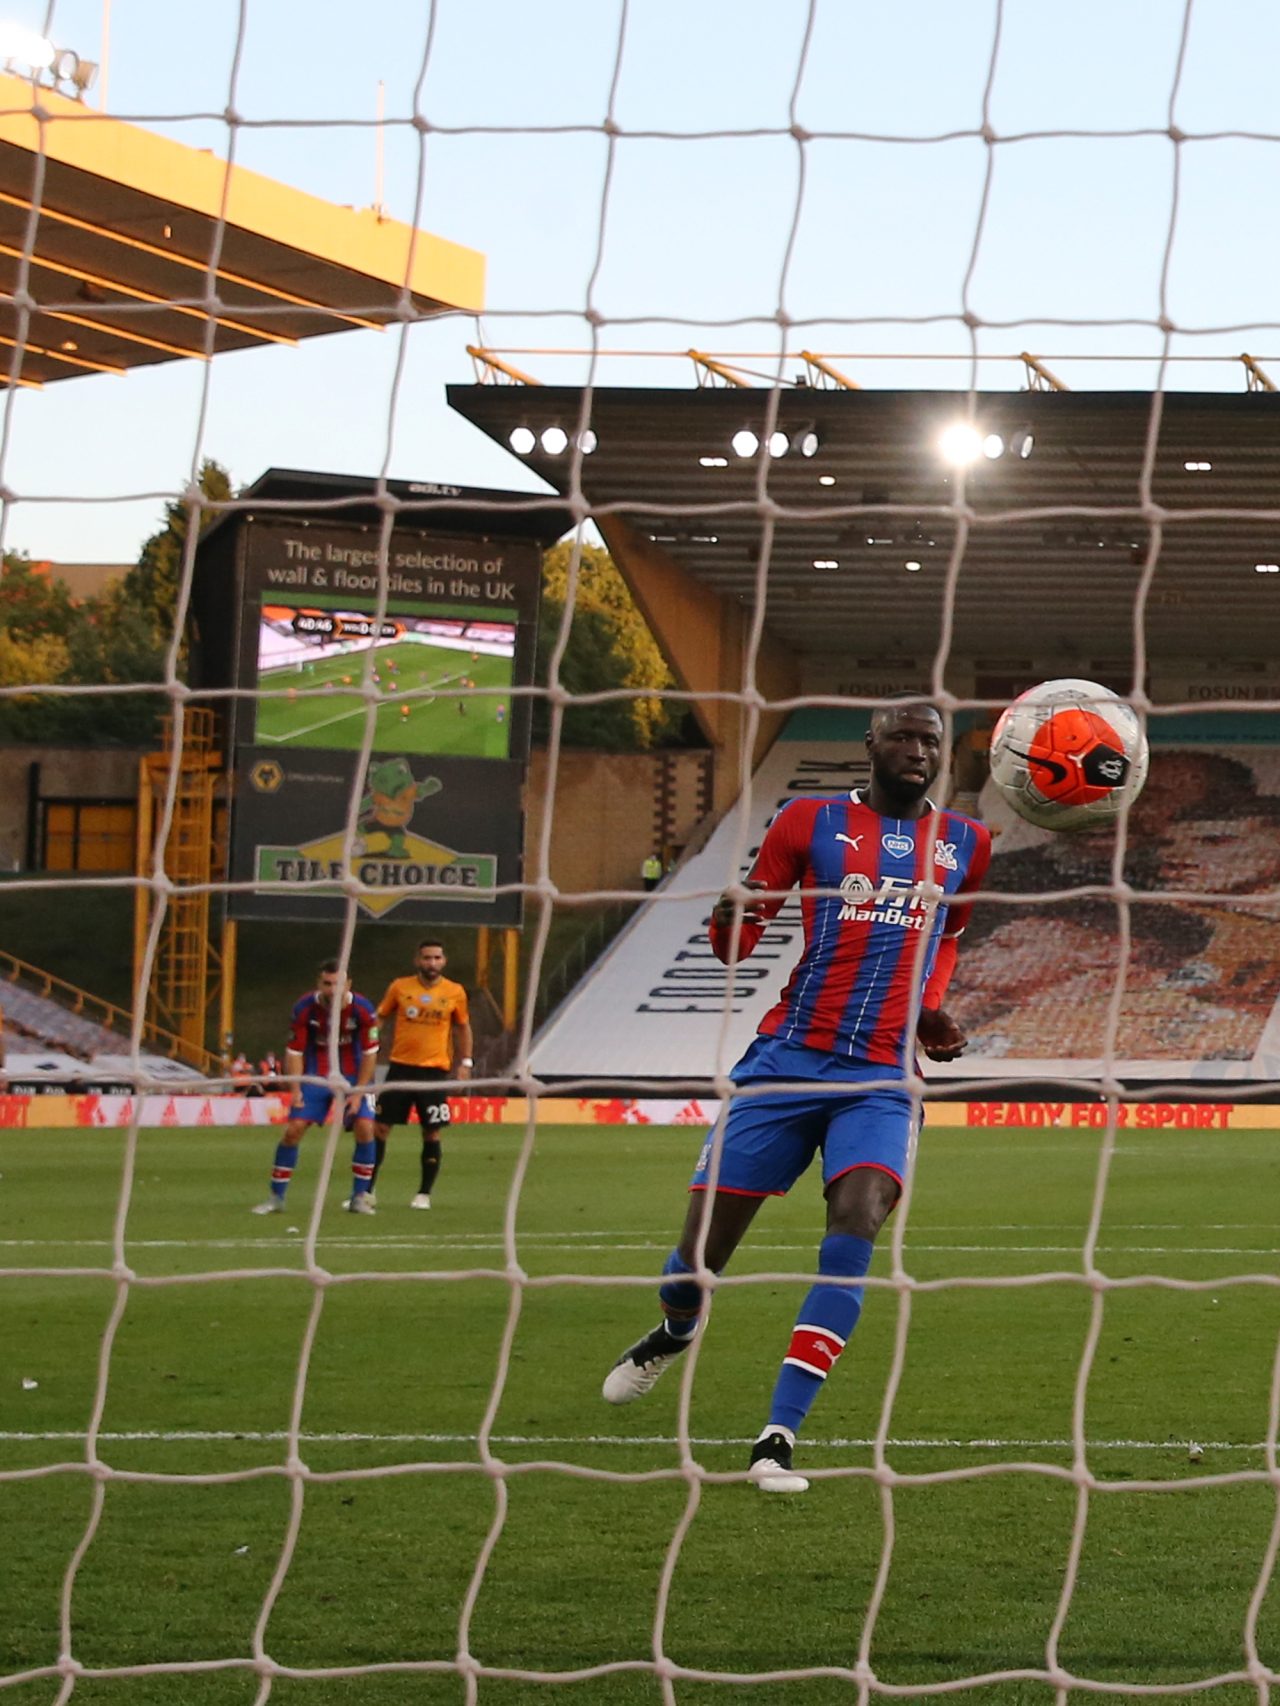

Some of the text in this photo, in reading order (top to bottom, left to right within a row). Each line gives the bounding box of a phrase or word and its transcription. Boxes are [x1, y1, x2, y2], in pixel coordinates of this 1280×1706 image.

[284, 540, 504, 575] The larges selection of
[267, 567, 308, 585] wall
[312, 568, 328, 587] &
[333, 570, 379, 590] floor
[427, 576, 445, 595] in
[450, 578, 481, 598] the
[485, 583, 515, 601] UK
[1188, 686, 1250, 700] FOSUN
[888, 841, 909, 850] NHS
[360, 863, 478, 887] CHOICE
[837, 905, 935, 930] ManBet
[427, 1103, 451, 1124] 28
[967, 1102, 1234, 1130] READY FOR SPORT
